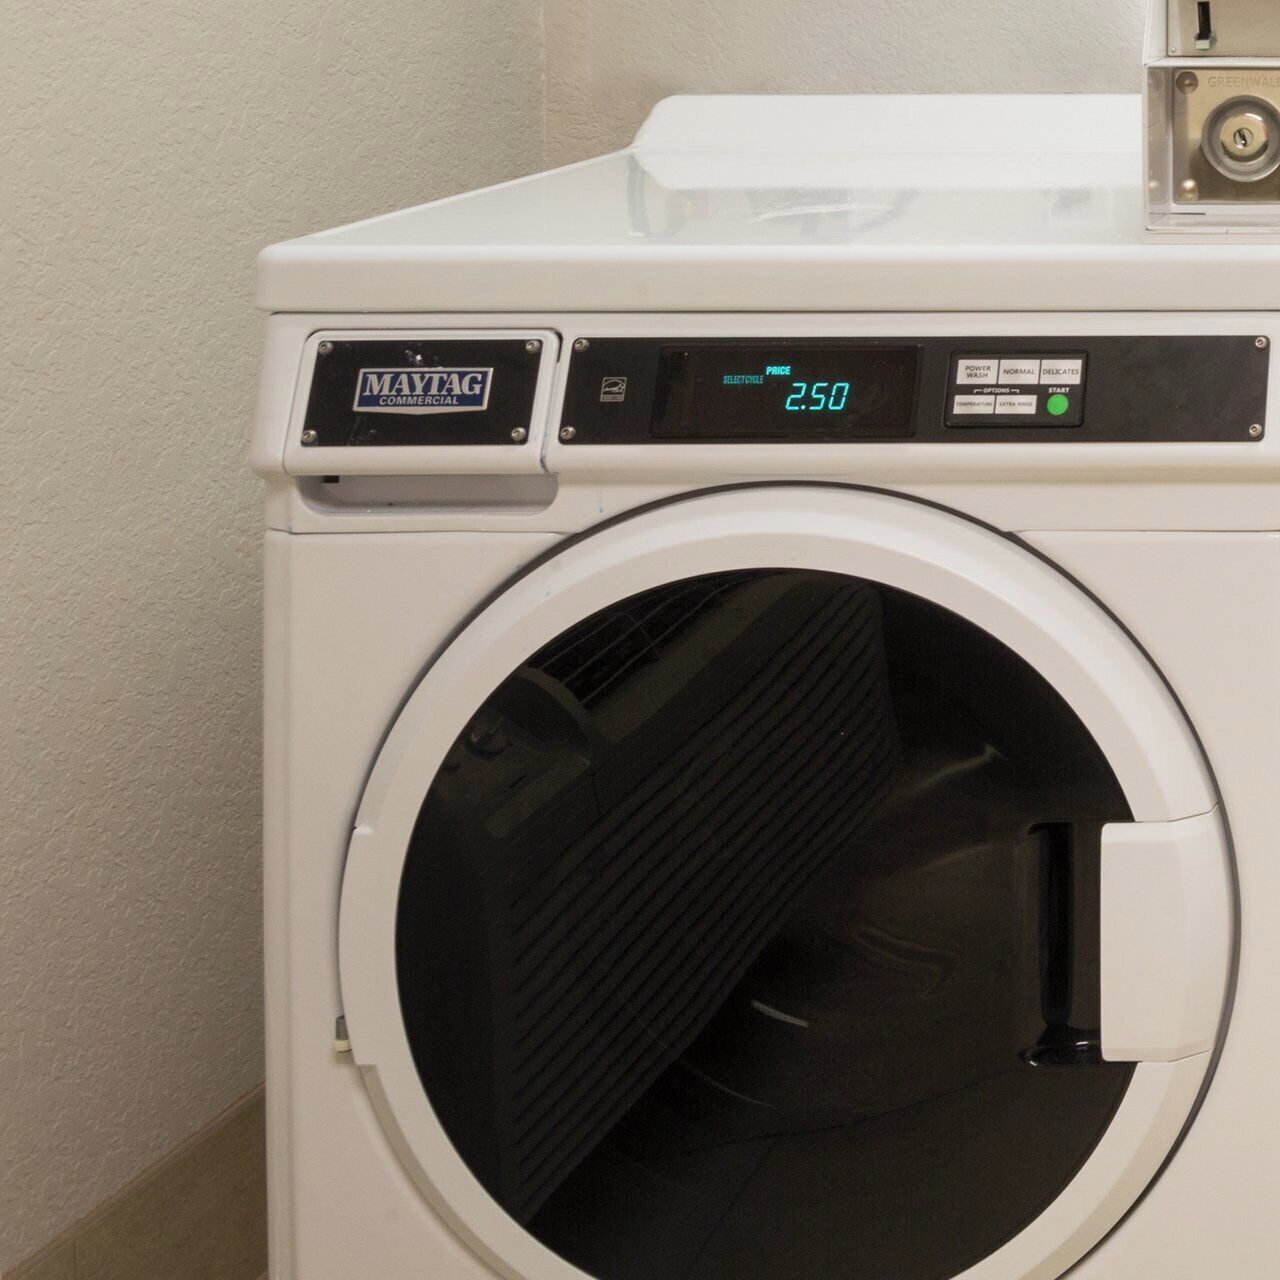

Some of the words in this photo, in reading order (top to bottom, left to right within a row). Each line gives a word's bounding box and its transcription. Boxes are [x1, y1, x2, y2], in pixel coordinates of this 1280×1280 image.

[766, 366, 791, 375] PRICE
[362, 373, 482, 395] MAYTAG
[723, 375, 745, 384] SELECT
[745, 375, 764, 384] CYCLE
[379, 396, 459, 405] COMMERCIAL
[785, 382, 849, 410] 2.50
